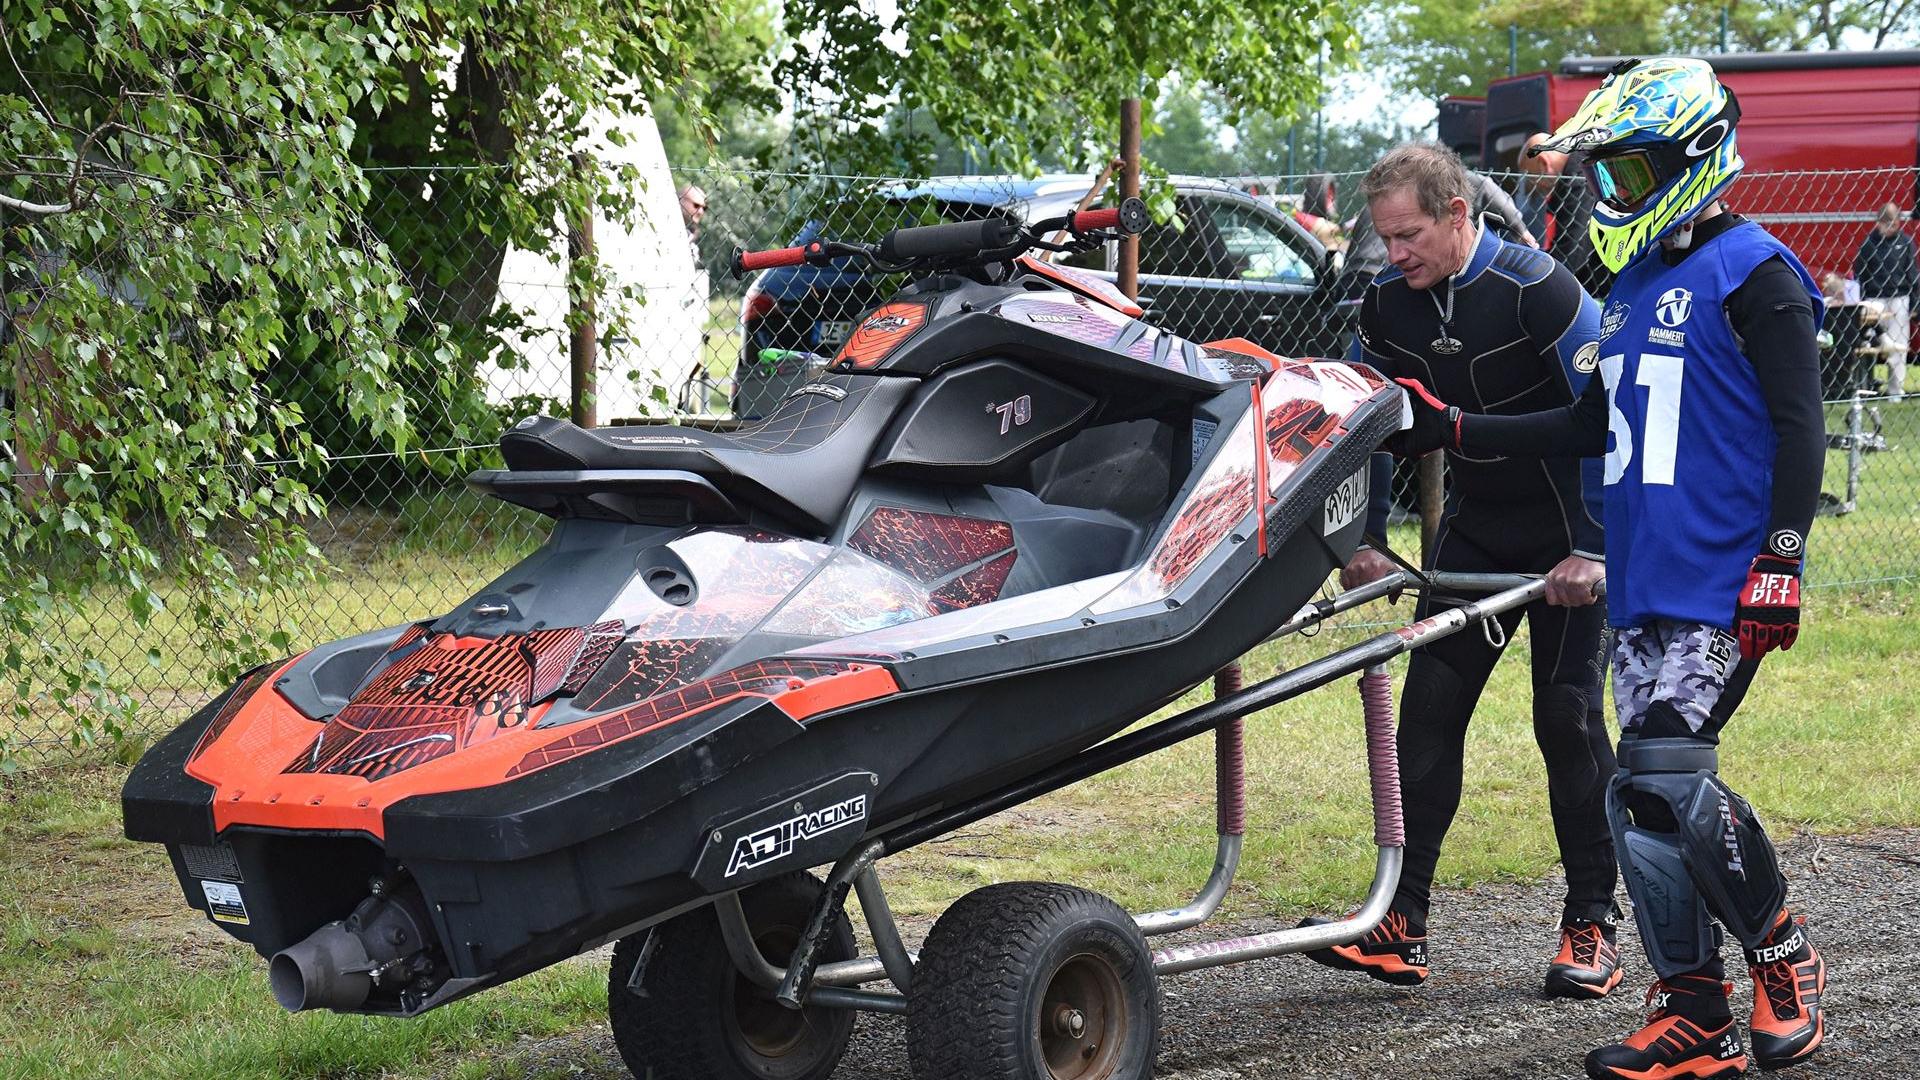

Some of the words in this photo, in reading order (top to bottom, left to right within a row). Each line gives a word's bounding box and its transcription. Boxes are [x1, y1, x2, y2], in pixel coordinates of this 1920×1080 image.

[1648, 326, 1686, 343] NAMMERT
[1753, 573, 1794, 590] JET
[791, 794, 867, 841] RACING
[1416, 945, 1421, 953] 8
[1752, 928, 1805, 963] TERREX
[1725, 1035, 1731, 1045] 9
[1728, 1042, 1740, 1055] 8.5
